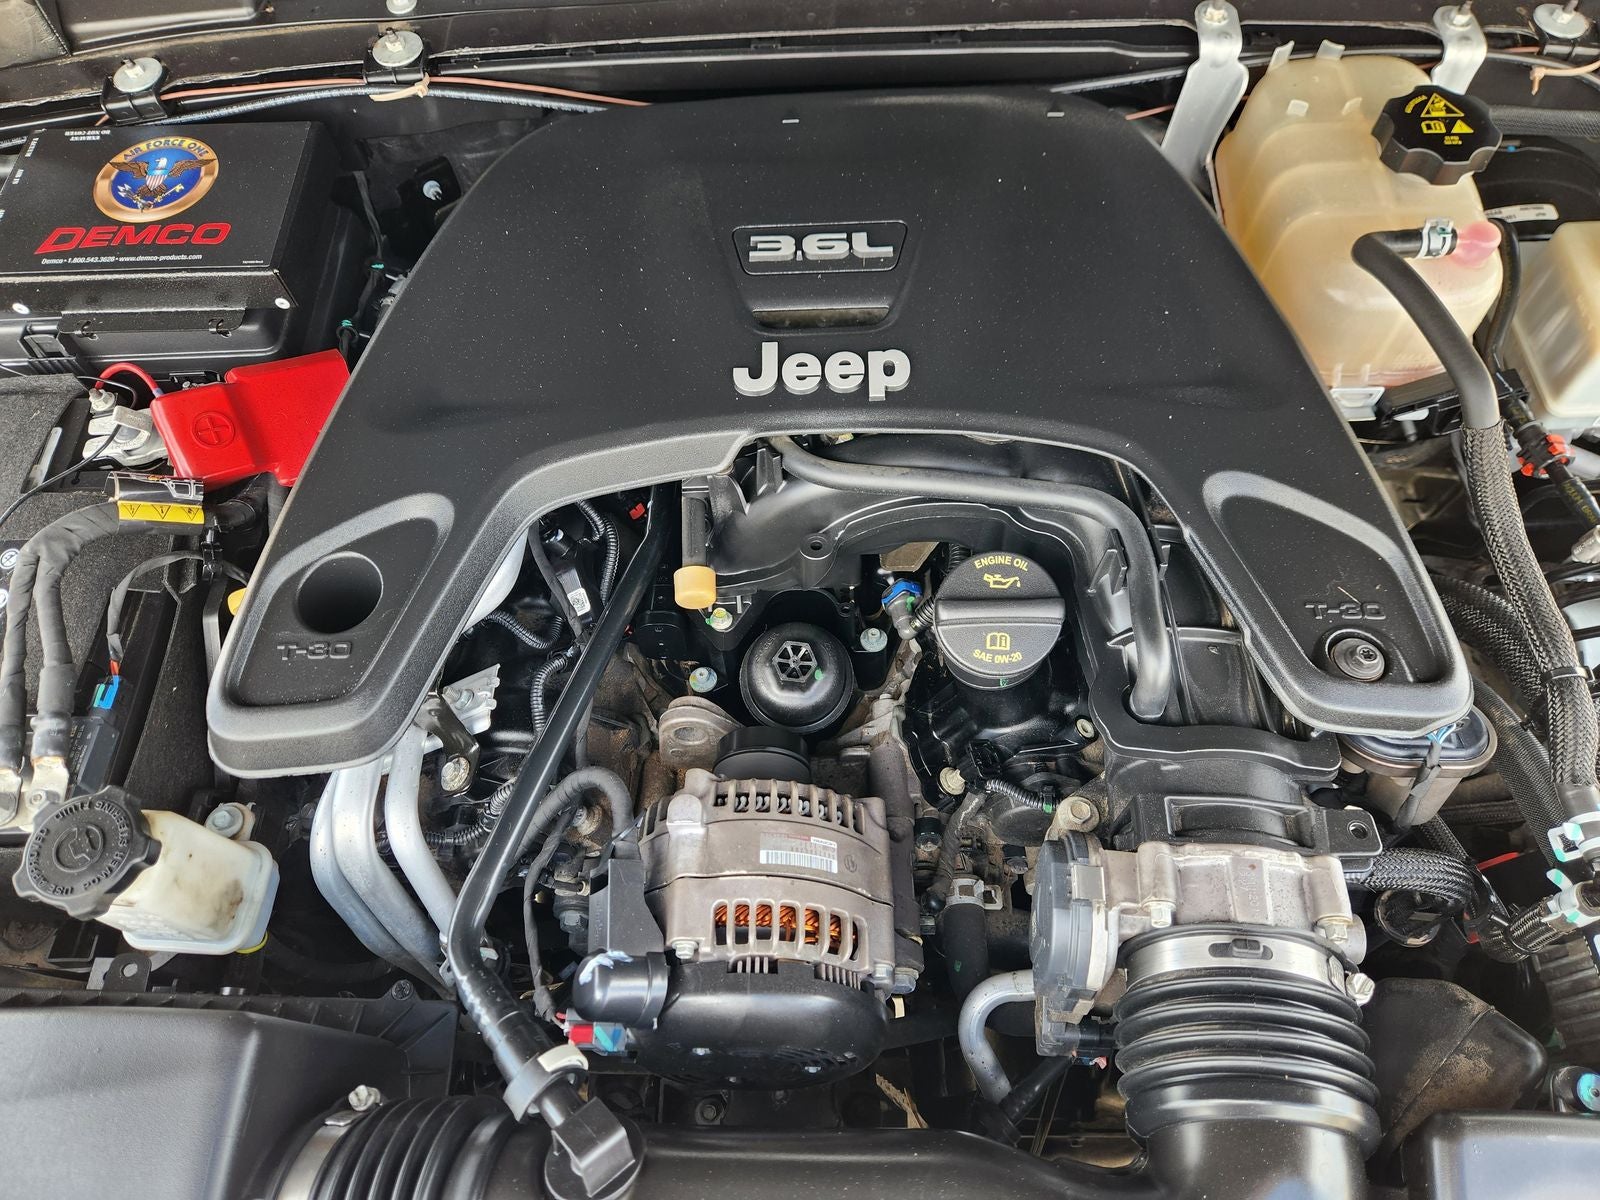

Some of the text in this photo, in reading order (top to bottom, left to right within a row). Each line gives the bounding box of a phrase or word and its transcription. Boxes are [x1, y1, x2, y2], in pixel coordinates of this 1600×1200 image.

[123, 138, 210, 161] AIR FORCE ONE
[34, 222, 231, 255] DEMCO
[749, 231, 894, 262] 3.6L
[41, 257, 63, 265] Demco
[118, 253, 203, 262] www.demco-products.com
[733, 341, 911, 402] Jeep
[974, 555, 1030, 572] ENGINE OIL
[1304, 602, 1387, 620] T-30
[275, 641, 353, 661] T-30
[972, 648, 1023, 664] SAE 0W-20
[54, 801, 93, 821] FLUID
[94, 801, 130, 848] STEERING
[28, 826, 75, 896] USE APPROVED
[82, 850, 125, 891] POWER
